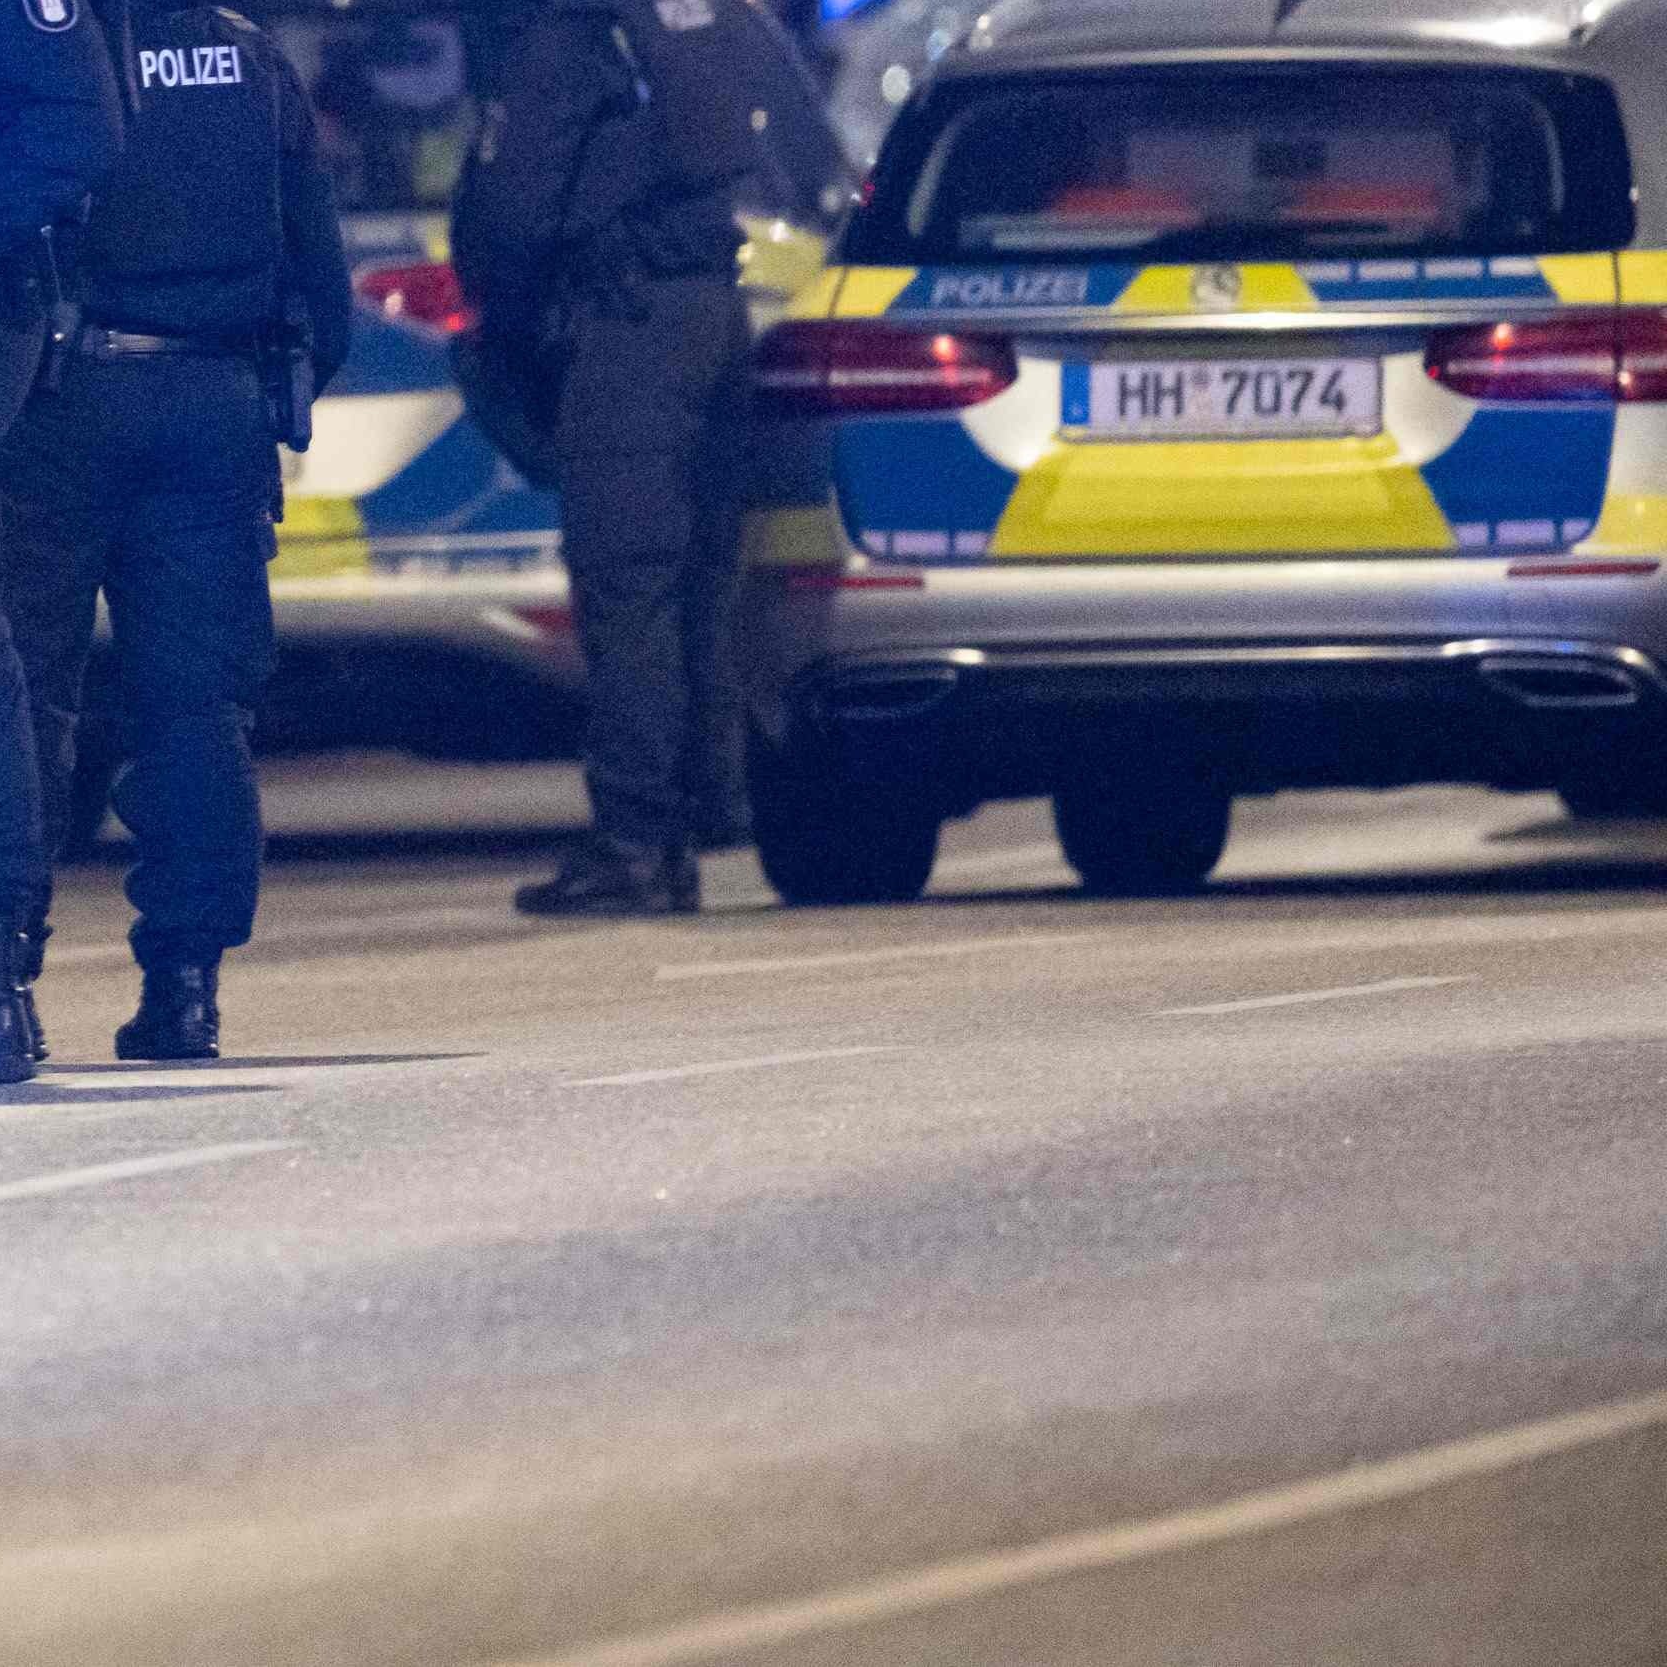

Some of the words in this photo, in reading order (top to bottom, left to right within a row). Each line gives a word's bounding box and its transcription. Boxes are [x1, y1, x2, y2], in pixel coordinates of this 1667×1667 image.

[139, 45, 242, 88] POLIZEI
[930, 265, 1089, 306] POLIZEI
[1118, 370, 1184, 418] HH
[1222, 368, 1346, 418] 7074
